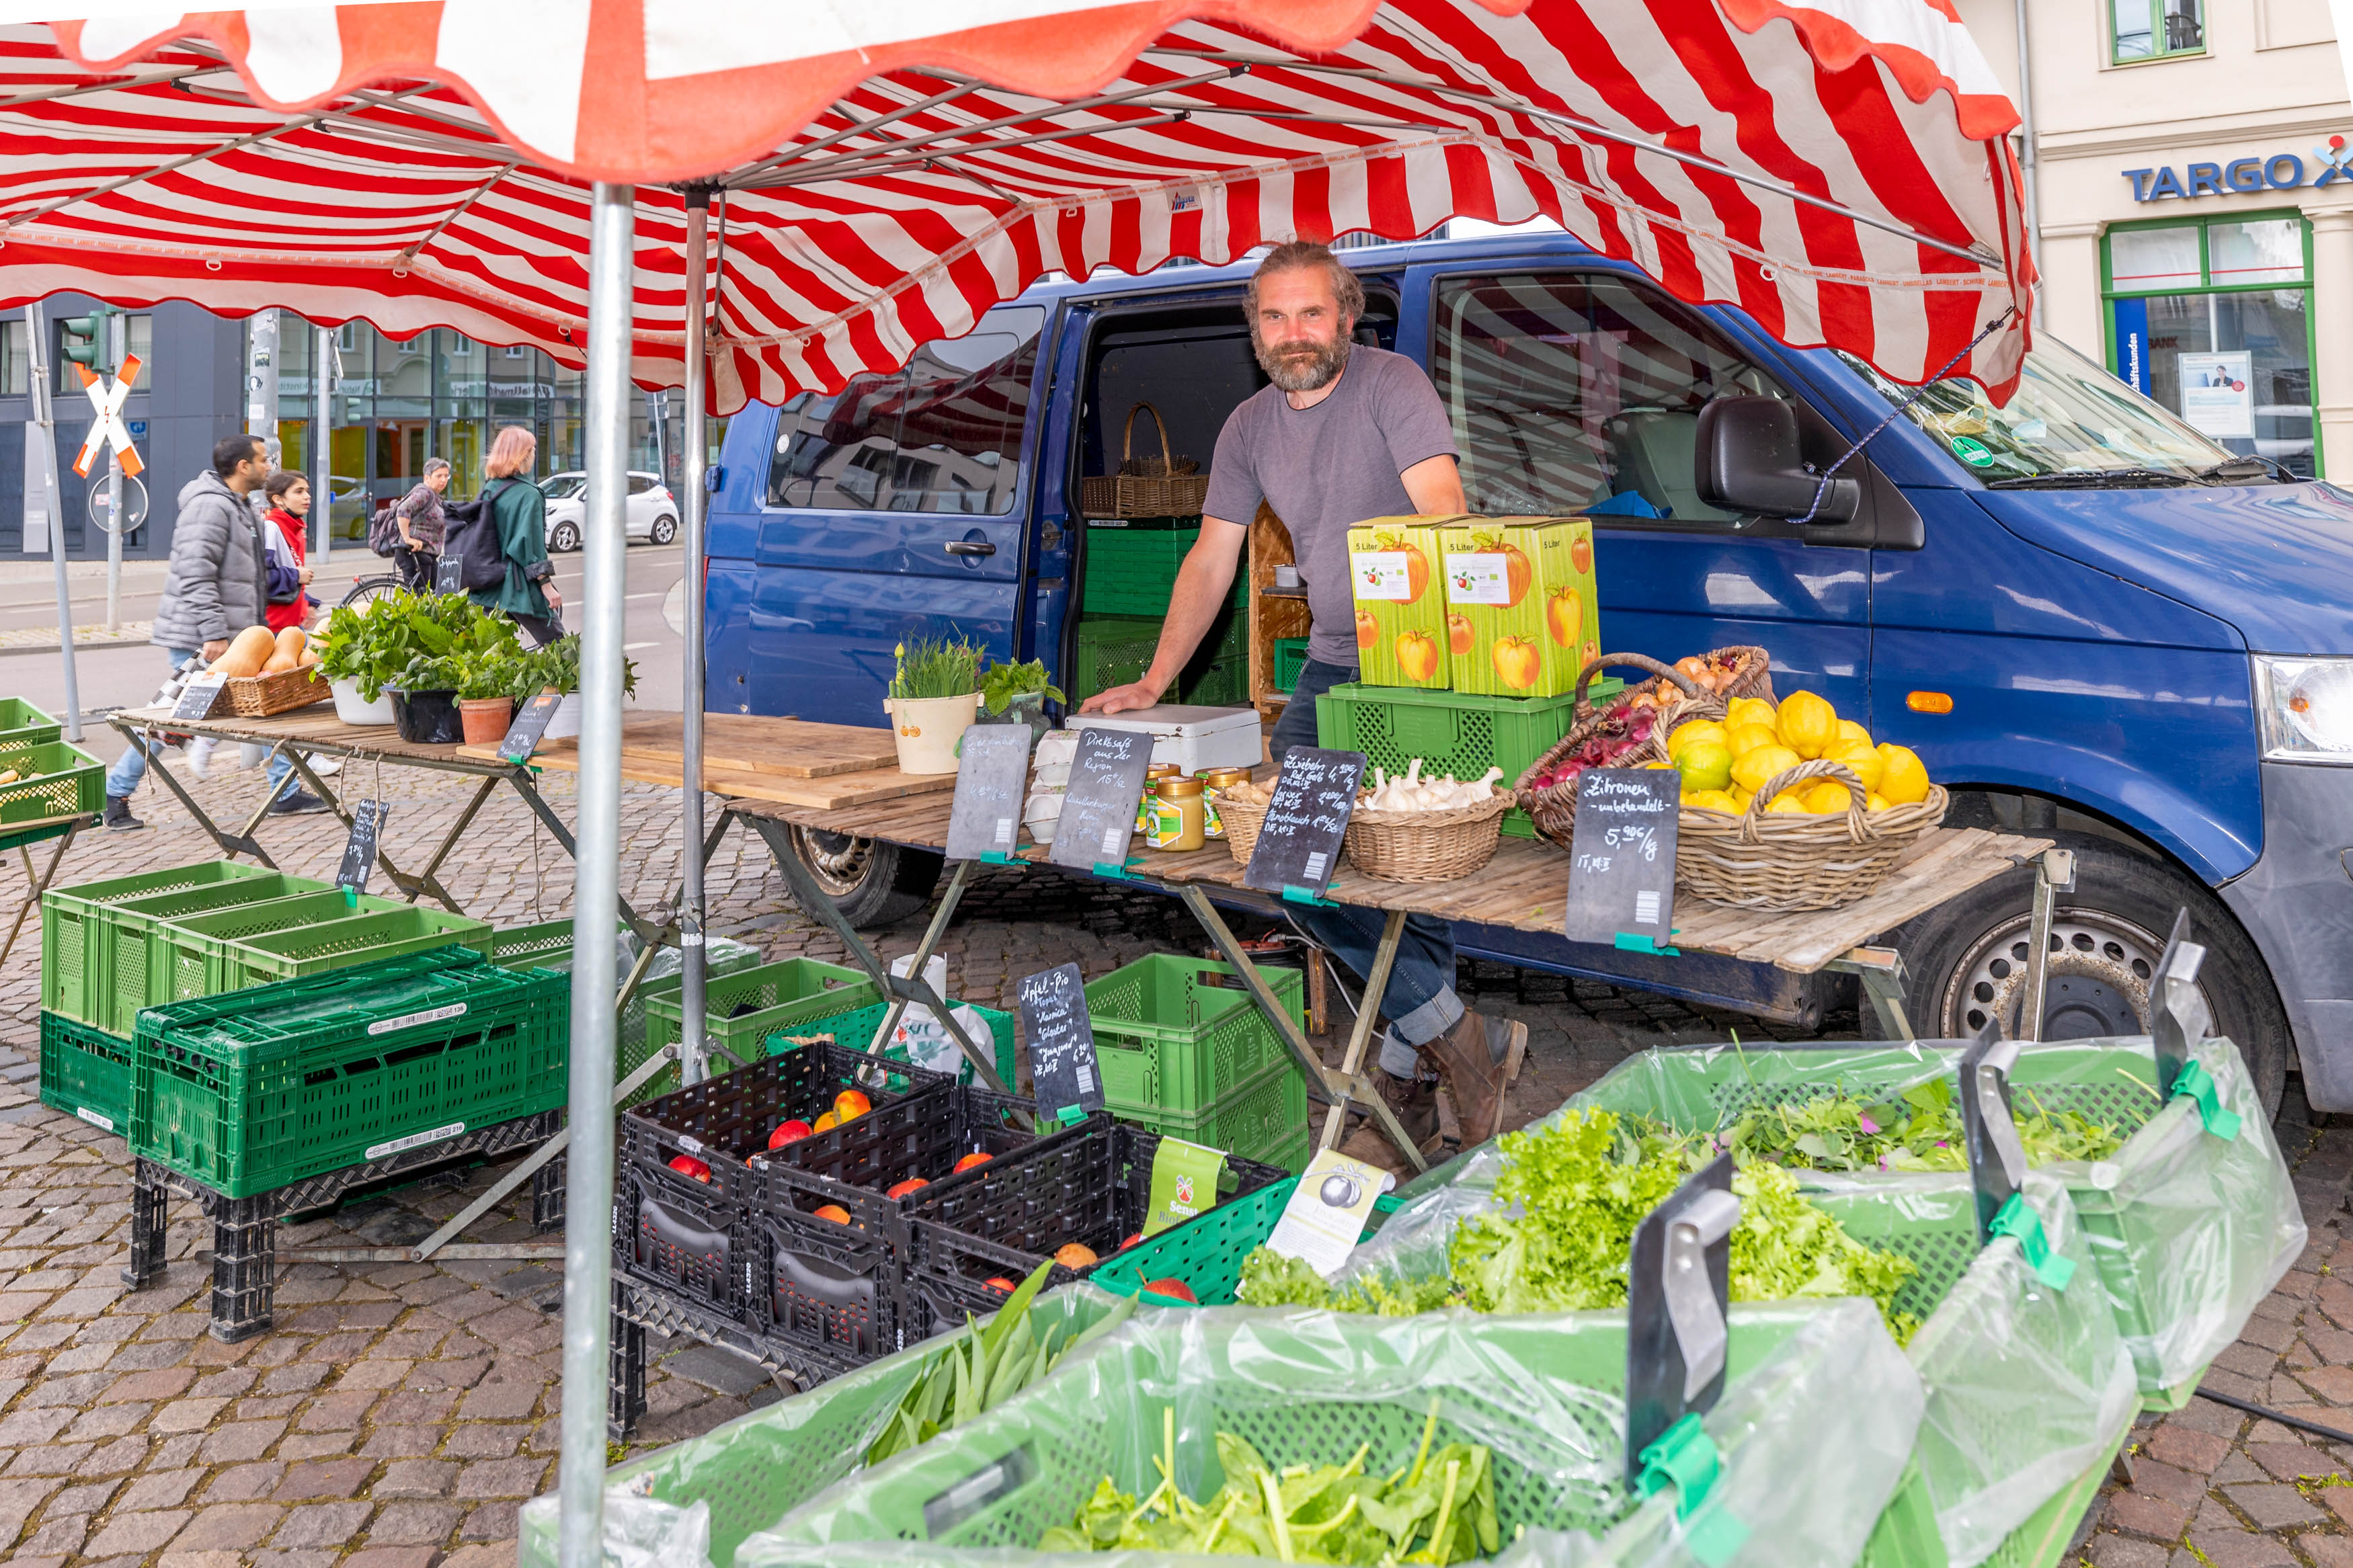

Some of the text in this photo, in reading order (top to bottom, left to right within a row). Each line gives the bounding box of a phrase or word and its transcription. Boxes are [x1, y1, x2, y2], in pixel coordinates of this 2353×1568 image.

[2121, 154, 2304, 202] TARGO
[1877, 278, 1899, 286] LAMBERT
[1988, 279, 2009, 288] LAMBERT
[1361, 542, 1378, 550] Liter
[1457, 543, 1474, 551] Liter
[1085, 731, 1133, 752] Direktsaft
[1094, 749, 1131, 760] aus der
[1084, 757, 1112, 773] Region
[1283, 754, 1326, 772] Zwiebeln
[1584, 774, 1650, 798] Zitronen
[1266, 808, 1310, 825] Knoblauch
[452, 1124, 463, 1132] 216
